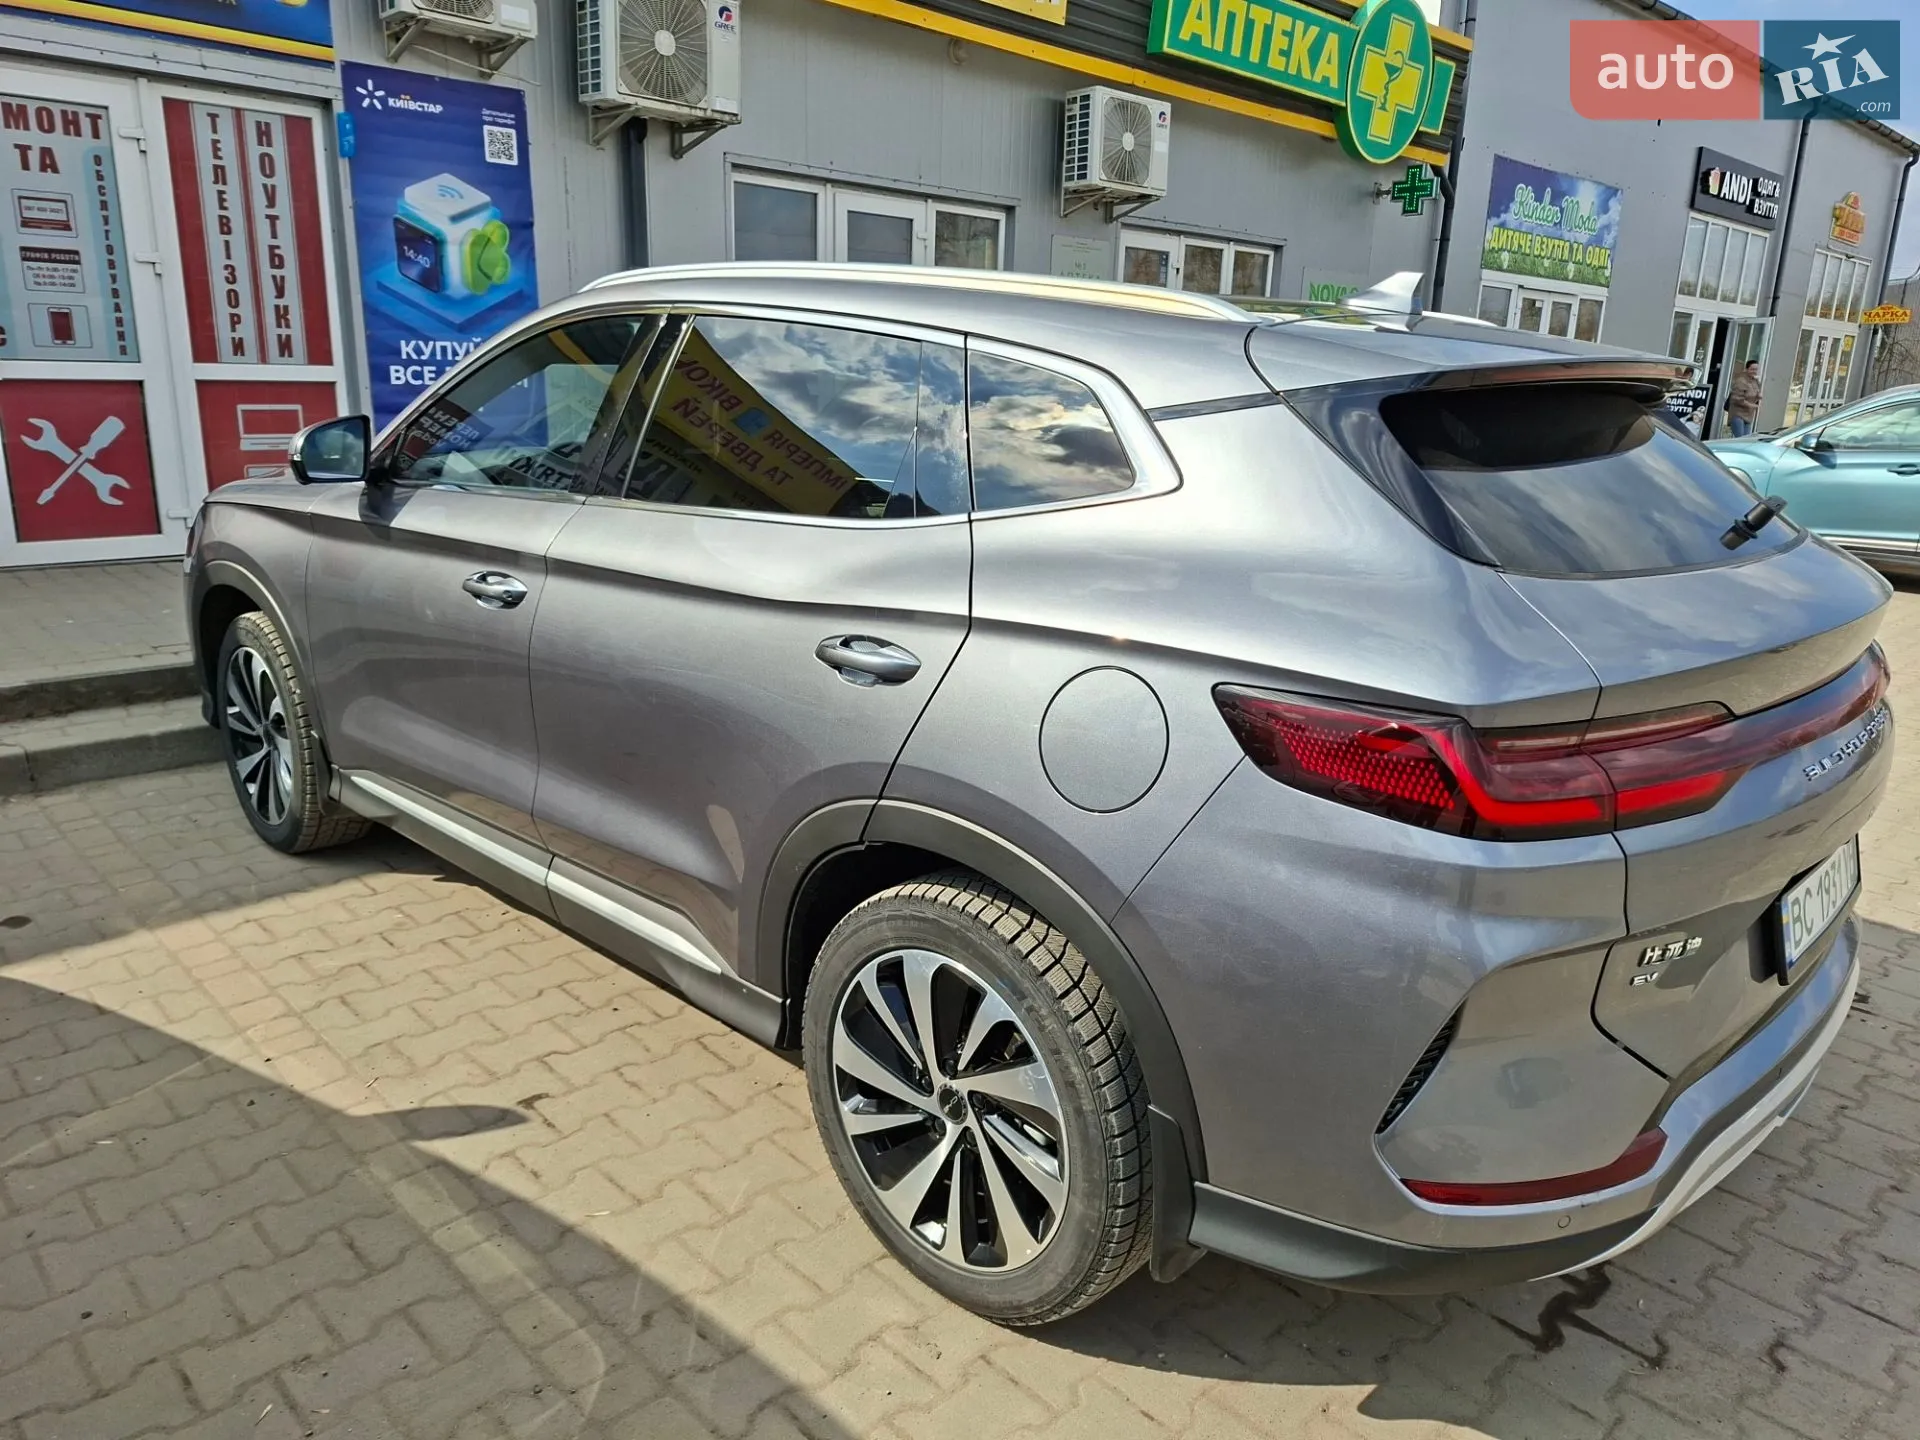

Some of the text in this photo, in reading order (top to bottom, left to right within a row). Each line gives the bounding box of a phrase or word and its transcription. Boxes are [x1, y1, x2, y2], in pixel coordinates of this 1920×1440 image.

[714, 21, 736, 31] GREE
[1179, 0, 1338, 89] АПТЕКА
[388, 94, 443, 114] КИЇВСТАР
[1, 102, 102, 140] МОНТ
[13, 143, 61, 174] ТА
[1720, 171, 1753, 206] ANDI
[1512, 183, 1599, 235] Kinder Moda
[1753, 198, 1779, 219] ВЗУТТЯ
[206, 112, 246, 357] ТЕЛЕВІЗОРИ
[255, 120, 293, 358] НОУТБУКИ
[1489, 226, 1611, 269] ДИТЯЧЕ ВЗУТТЯ ТА ОДЯГ
[93, 154, 128, 356] ОБСЛУГОВУВАННЯ
[1863, 310, 1908, 319] ЧАРКА
[389, 365, 437, 386] ВСЕ
[1667, 405, 1693, 413] ЗУТТЯ
[1790, 886, 1814, 951] BC
[1643, 936, 1702, 963] 比亚迪
[1633, 971, 1659, 985] EV
